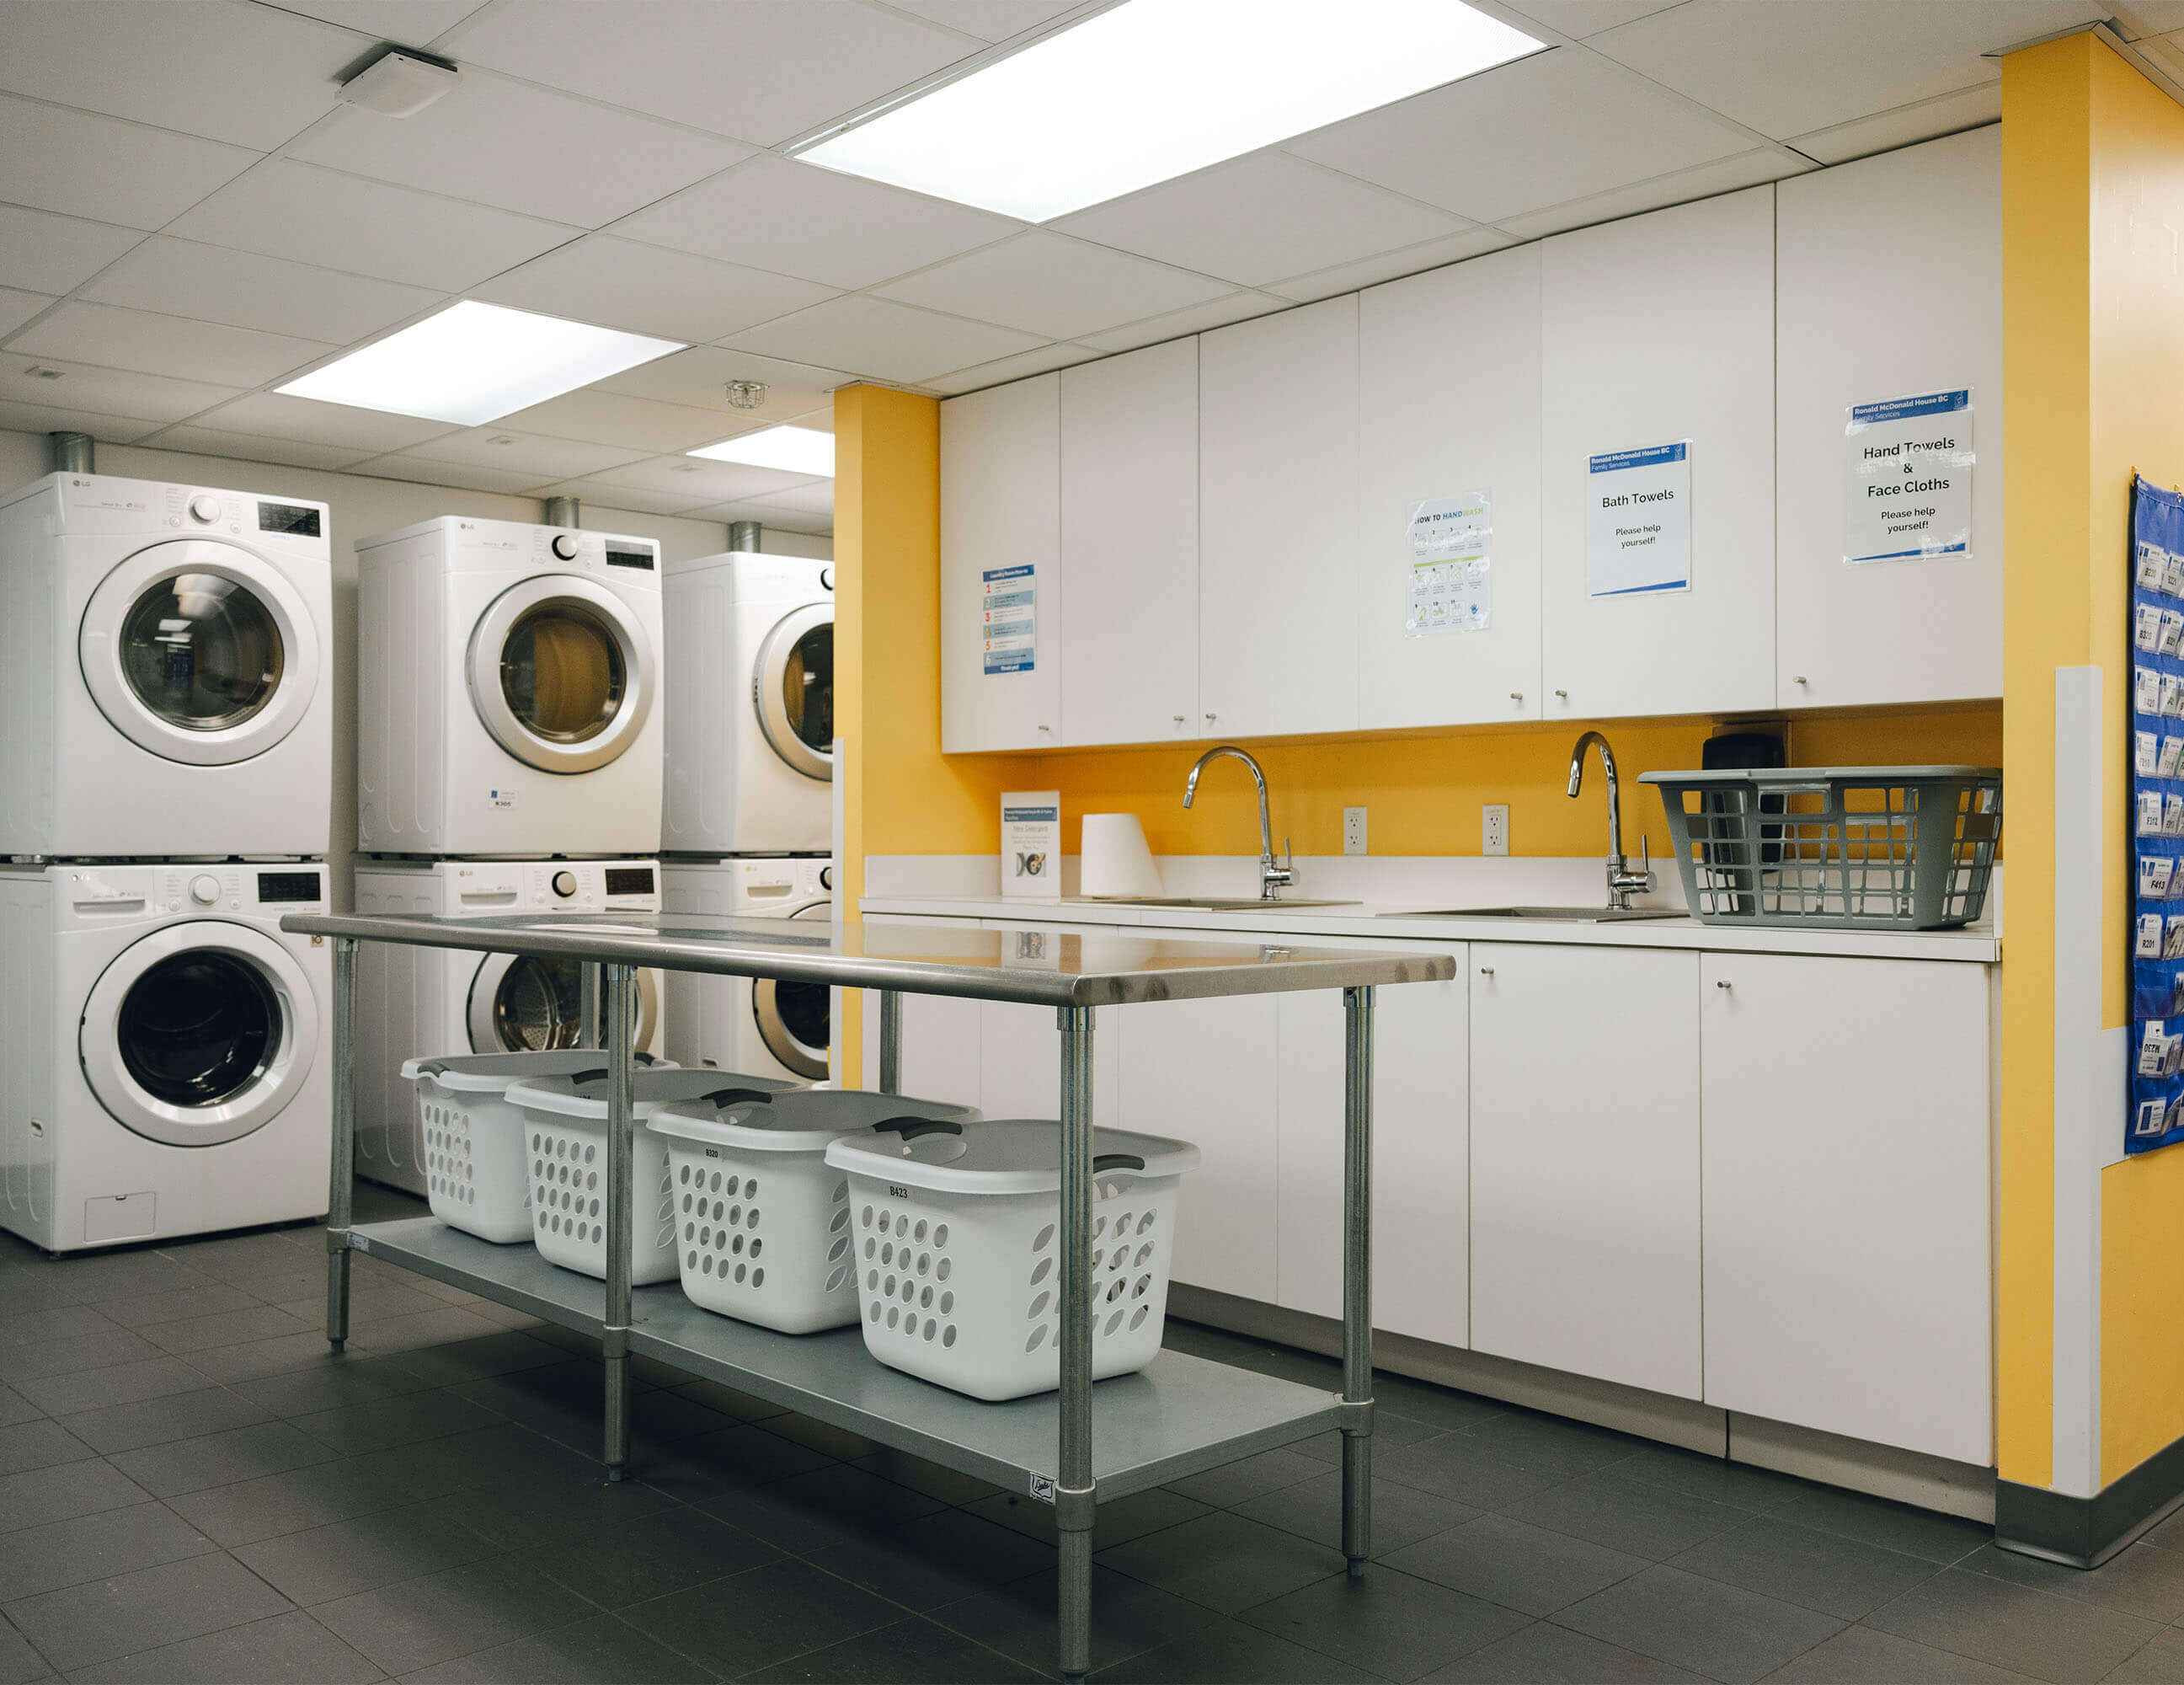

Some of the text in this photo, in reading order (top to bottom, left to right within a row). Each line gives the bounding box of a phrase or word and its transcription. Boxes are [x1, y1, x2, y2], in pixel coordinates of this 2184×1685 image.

[1855, 394, 1948, 415] Ronald McDonald House BC
[1875, 410, 1900, 420] Services
[1864, 436, 1955, 459] Hand Towels
[1591, 456, 1611, 464] Ronald
[1612, 452, 1642, 461] McDonald
[1591, 463, 1608, 472] Family
[1904, 463, 1914, 473] &
[1868, 478, 1950, 498] Face Cloths
[1603, 489, 1674, 508] Bath Towels
[1881, 506, 1936, 520] Please help
[1615, 523, 1661, 536] Please help
[1888, 521, 1929, 534] yourself!
[1621, 537, 1656, 549] yourself!
[986, 583, 991, 593] 1
[985, 612, 991, 622] 3
[985, 627, 991, 637] 4
[985, 640, 991, 650] 5
[2150, 880, 2165, 890] F413
[2142, 939, 2155, 949] R201
[705, 1148, 718, 1158] B320
[889, 1185, 908, 1199] B423
